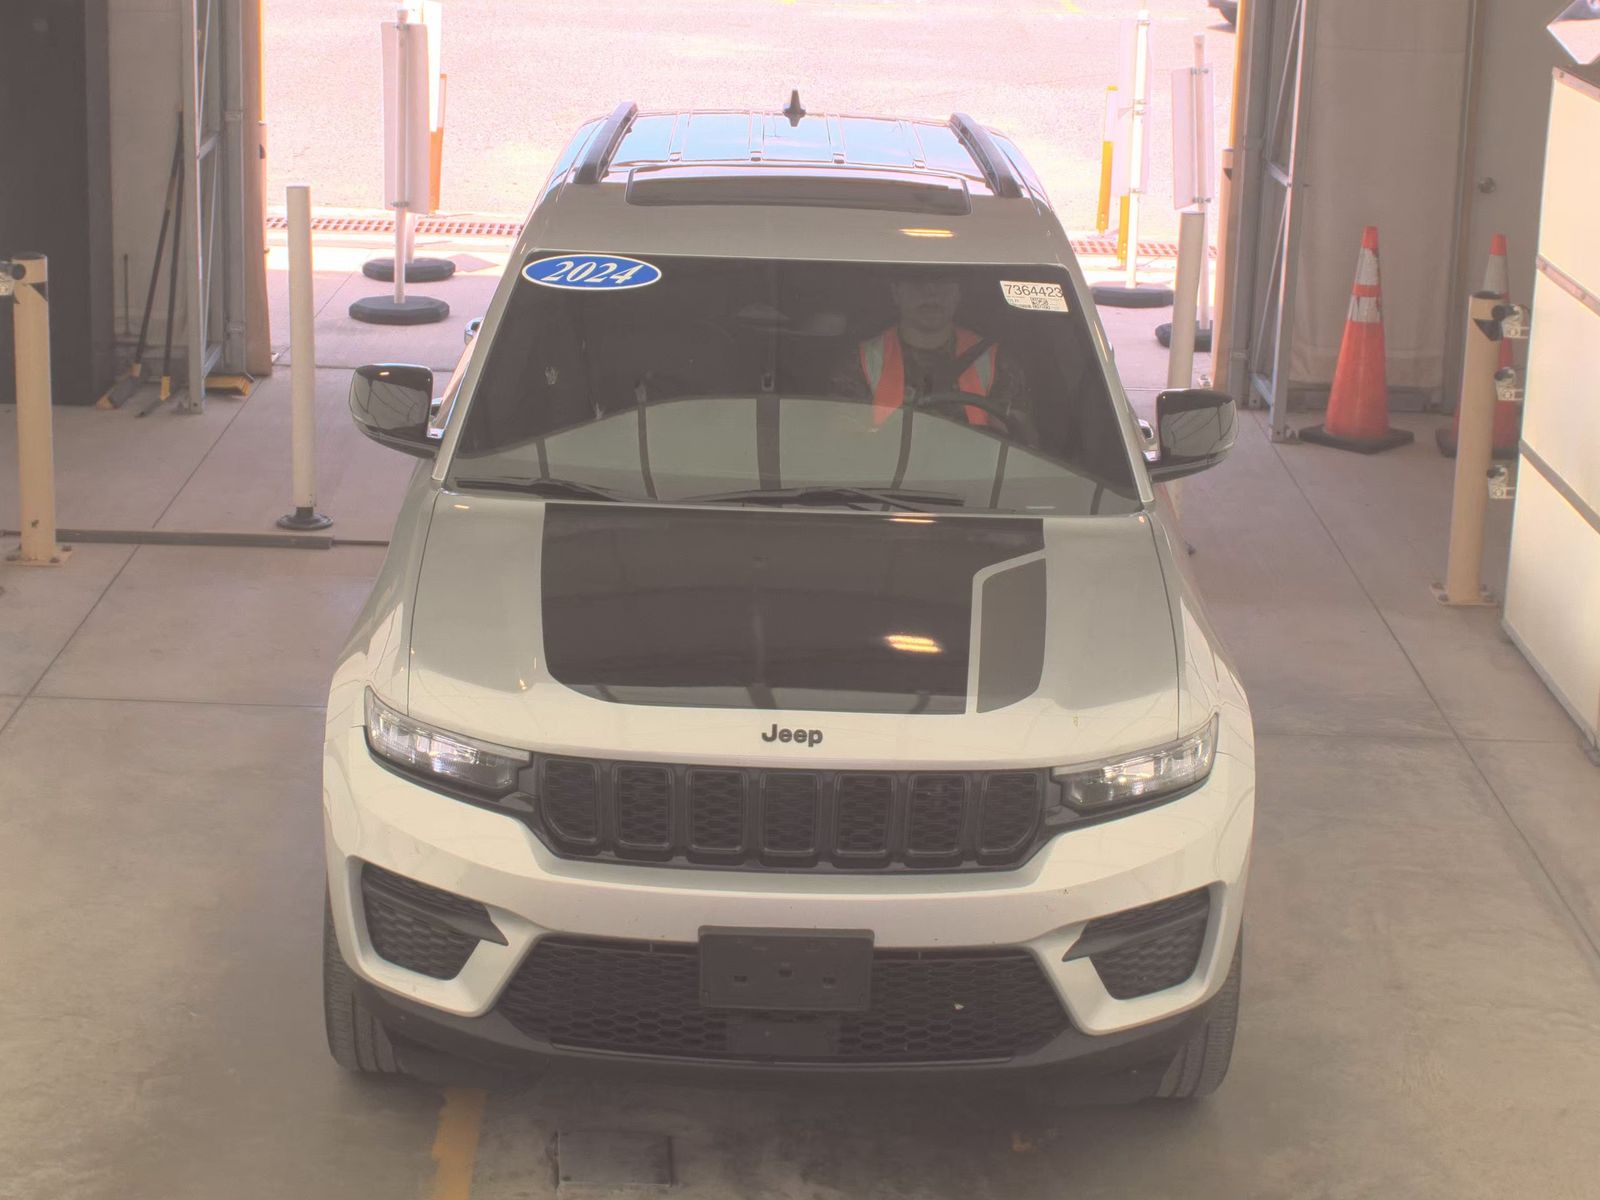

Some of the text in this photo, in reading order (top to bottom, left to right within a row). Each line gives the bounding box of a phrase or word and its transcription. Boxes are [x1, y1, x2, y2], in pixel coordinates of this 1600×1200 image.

[540, 261, 645, 284] 2024
[1004, 284, 1064, 298] 7364423
[761, 723, 823, 748] Jeep
